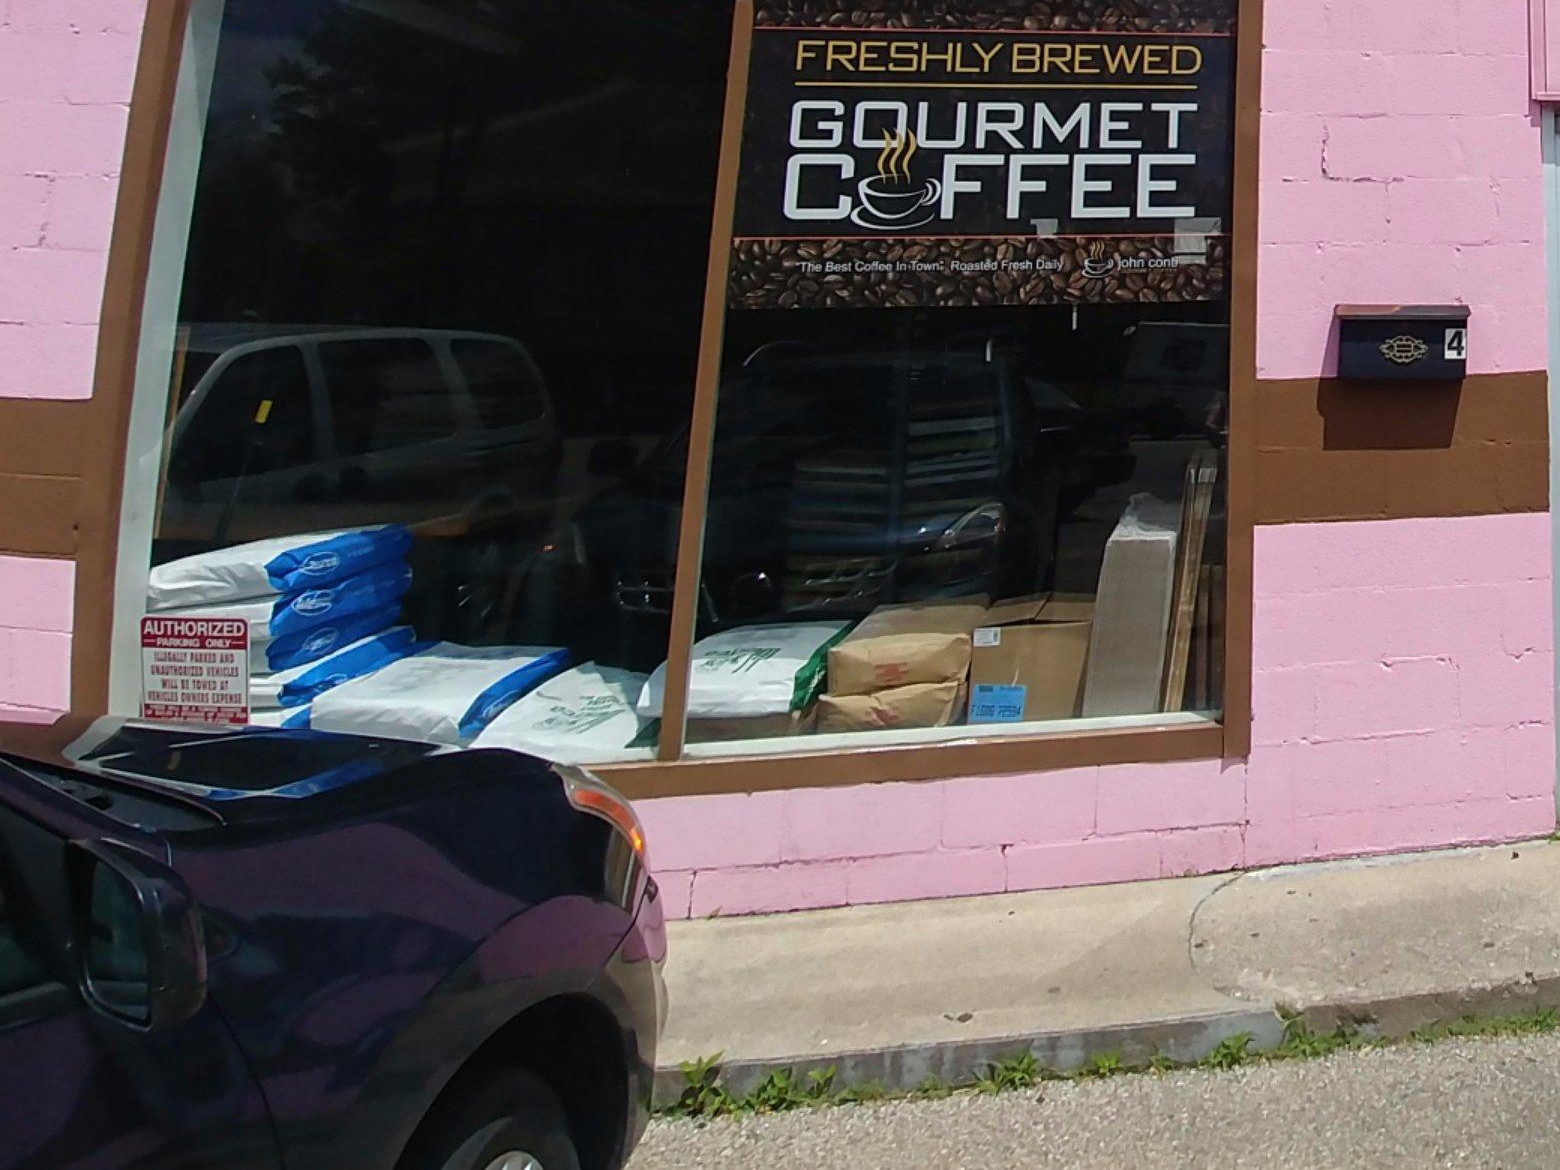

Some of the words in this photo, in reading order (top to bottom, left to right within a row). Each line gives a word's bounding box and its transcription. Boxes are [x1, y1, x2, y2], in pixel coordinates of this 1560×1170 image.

[795, 39, 1004, 74] FRESHLY
[1011, 42, 1203, 76] BREWED
[788, 99, 1198, 149] GOURMET
[825, 261, 852, 272] Best
[854, 261, 893, 272] Coffee
[951, 260, 998, 271] Roasted
[1001, 259, 1033, 271] Fresh
[1036, 258, 1063, 271] Daily
[1447, 330, 1465, 357] 4
[143, 620, 245, 637] AUTHORIZED
[156, 637, 200, 647] PARKING
[205, 638, 232, 648] ONLY
[154, 651, 187, 662] ILLEGALLY
[190, 652, 217, 663] PARKED
[220, 653, 235, 664] AND
[151, 664, 204, 676] UNAUTHORIZED
[207, 667, 240, 677] VEHICLES
[192, 680, 217, 690] TOWED
[212, 693, 243, 704] EXPENSE
